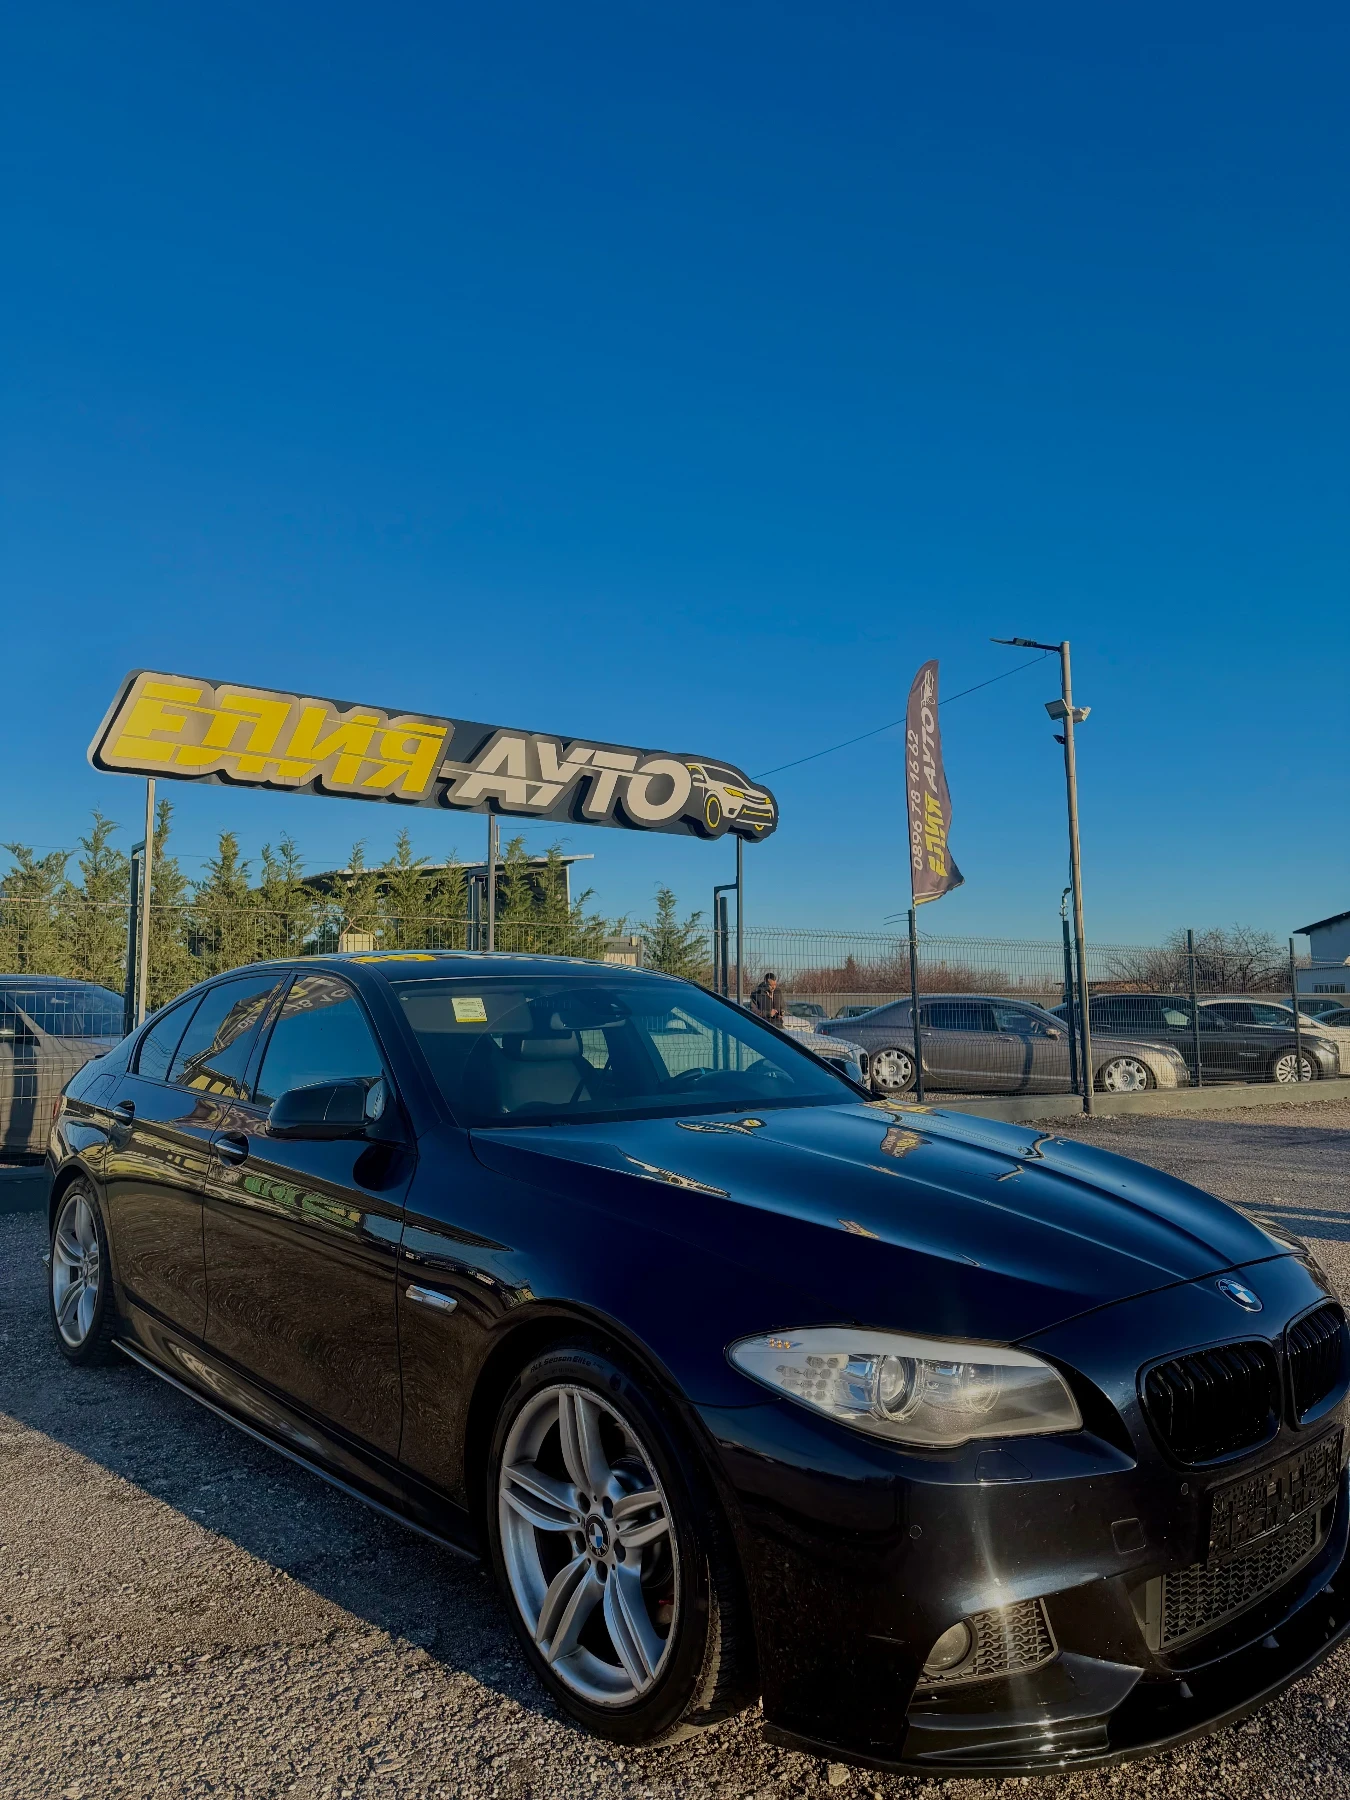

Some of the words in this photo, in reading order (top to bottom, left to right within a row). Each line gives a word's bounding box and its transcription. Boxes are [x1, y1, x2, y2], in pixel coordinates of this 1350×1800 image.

[907, 729, 919, 757] 62
[921, 706, 938, 794] АУТО
[909, 760, 920, 783] 16
[910, 790, 922, 816] 78
[912, 820, 923, 871] 0896
[543, 1355, 572, 1366] Season
[572, 1355, 592, 1367] Elite
